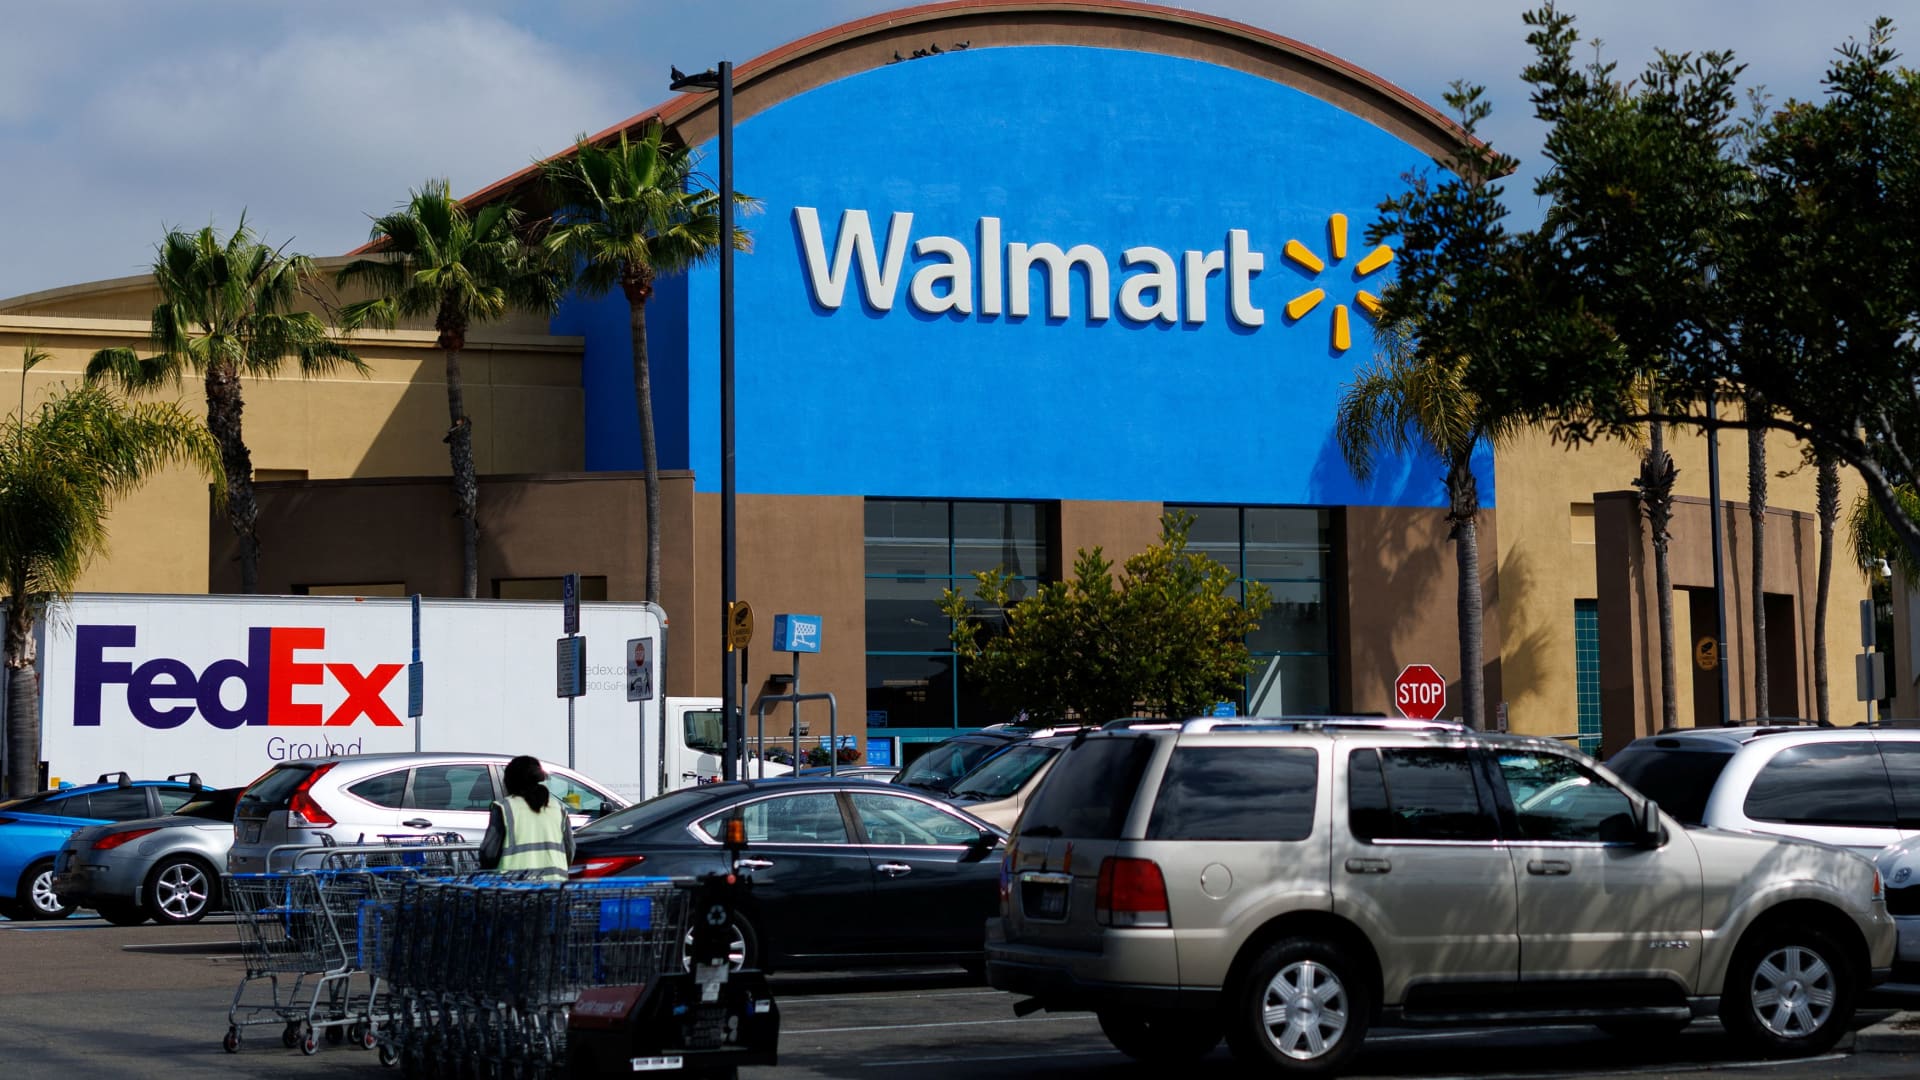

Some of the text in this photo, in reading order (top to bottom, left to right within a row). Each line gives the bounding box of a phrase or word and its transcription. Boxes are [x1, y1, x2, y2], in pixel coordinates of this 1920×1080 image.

[795, 206, 1265, 327] Walmart
[73, 624, 405, 730] FedEx
[1399, 683, 1442, 704] STOP
[267, 736, 362, 761] Ground
